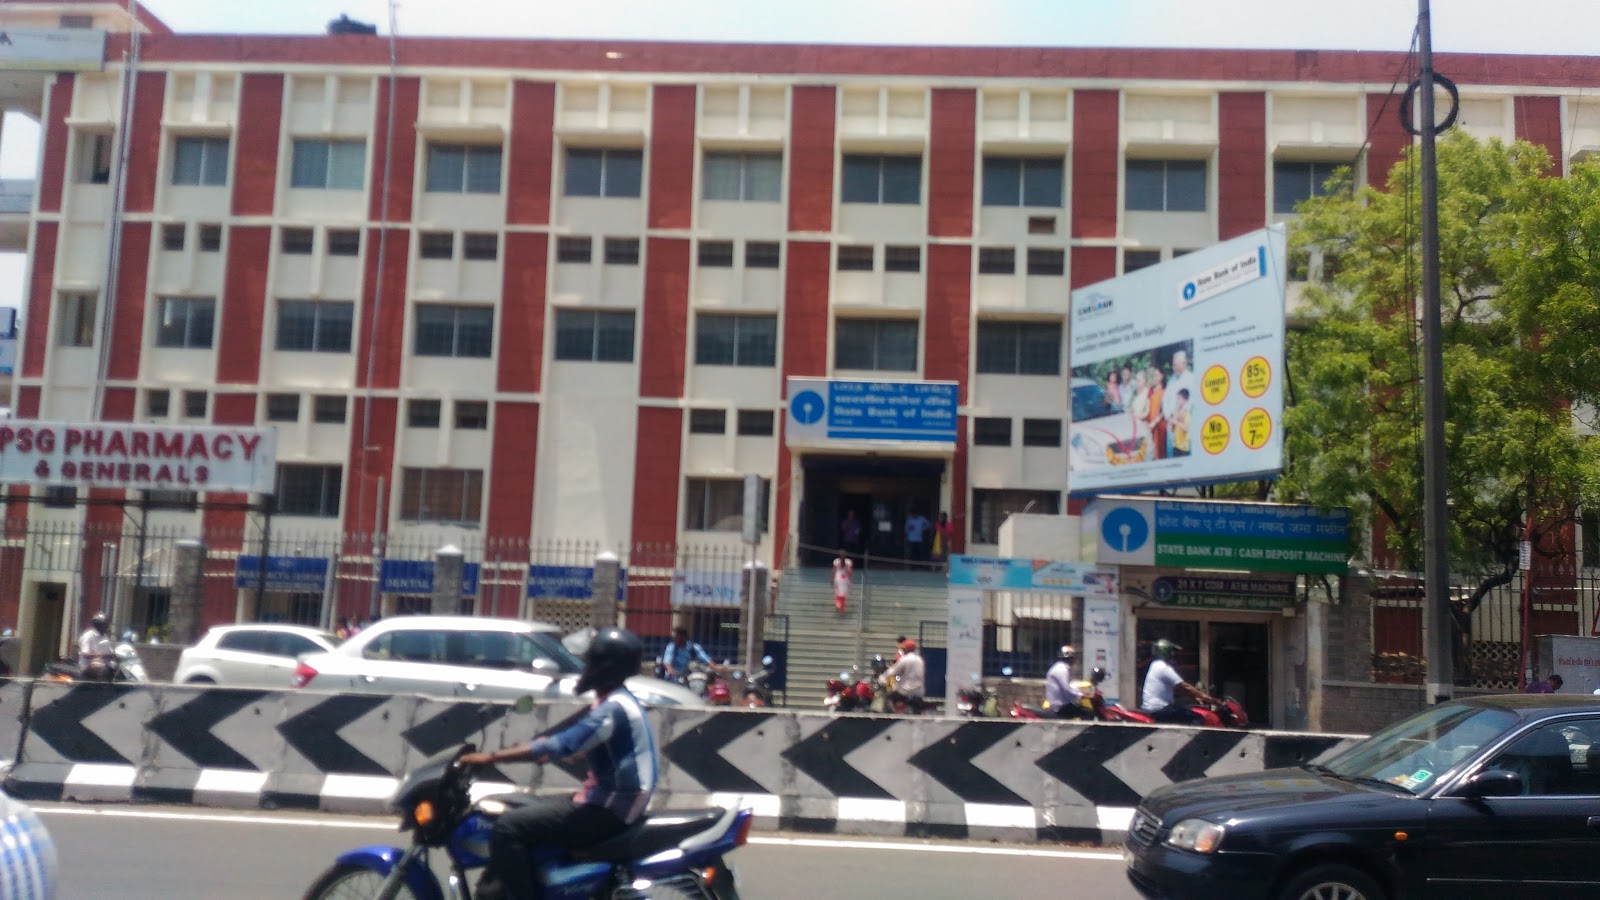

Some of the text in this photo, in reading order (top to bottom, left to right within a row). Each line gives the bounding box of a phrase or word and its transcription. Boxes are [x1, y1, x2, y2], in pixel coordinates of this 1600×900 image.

[1197, 276, 1212, 287] State
[1214, 268, 1230, 281] Bank
[1231, 262, 1239, 273] of
[1240, 256, 1257, 269] India
[1246, 363, 1267, 378] 85%
[833, 406, 953, 420] State Bank of India
[1209, 420, 1222, 433] No
[0, 427, 262, 462] PSG PHARMACY
[1249, 430, 1257, 446] 7
[34, 459, 209, 484] & GENERALS
[1157, 544, 1185, 556] STATE
[1186, 545, 1212, 557] BANK
[1213, 546, 1233, 558] ATM
[1239, 547, 1264, 559] CASH
[1265, 549, 1303, 561] DEPOSIT
[1304, 551, 1347, 563] MACHINE
[384, 578, 430, 590] DENTAL
[1229, 582, 1249, 592] ATM
[1250, 583, 1290, 593] MACHINE
